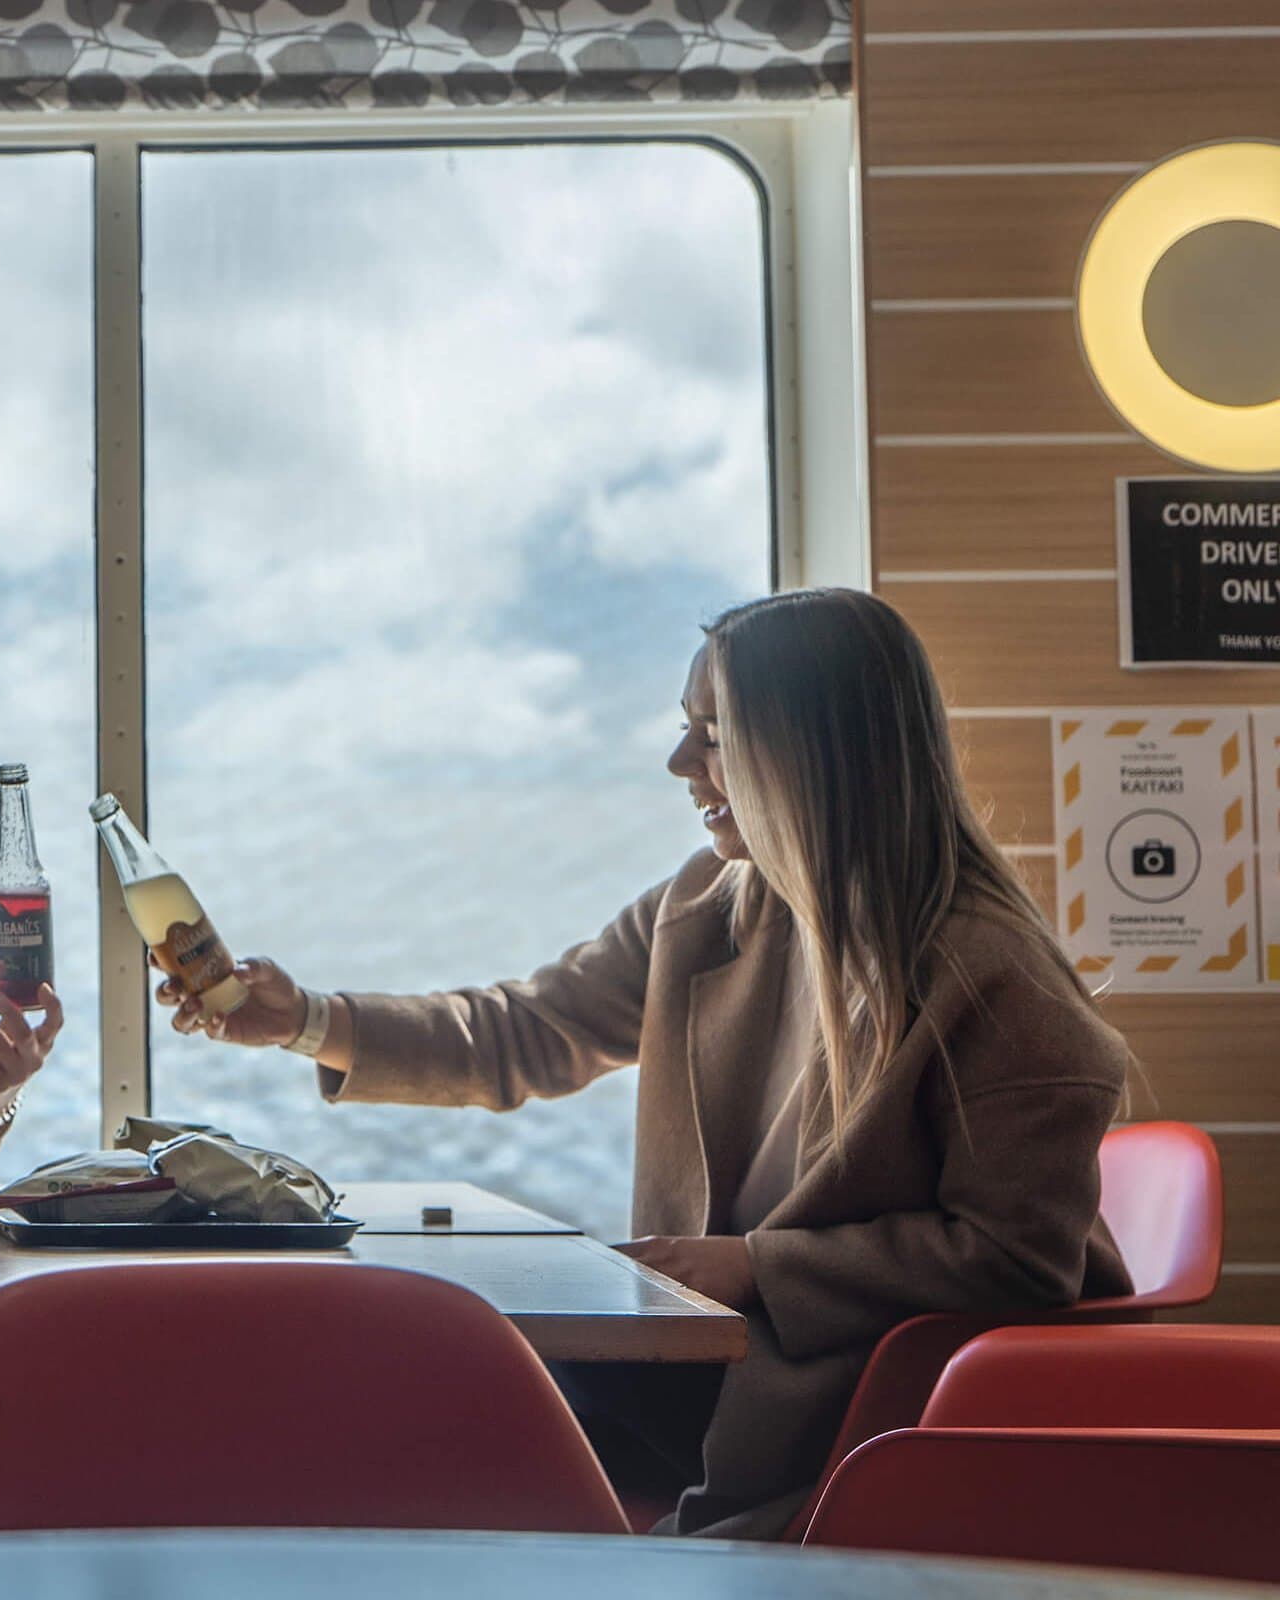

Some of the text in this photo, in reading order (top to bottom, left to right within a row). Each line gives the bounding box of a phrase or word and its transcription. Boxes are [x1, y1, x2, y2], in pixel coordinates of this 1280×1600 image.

[1200, 540, 1280, 565] DRIVE
[1219, 634, 1261, 649] THANK
[1120, 779, 1184, 795] KAITAKI
